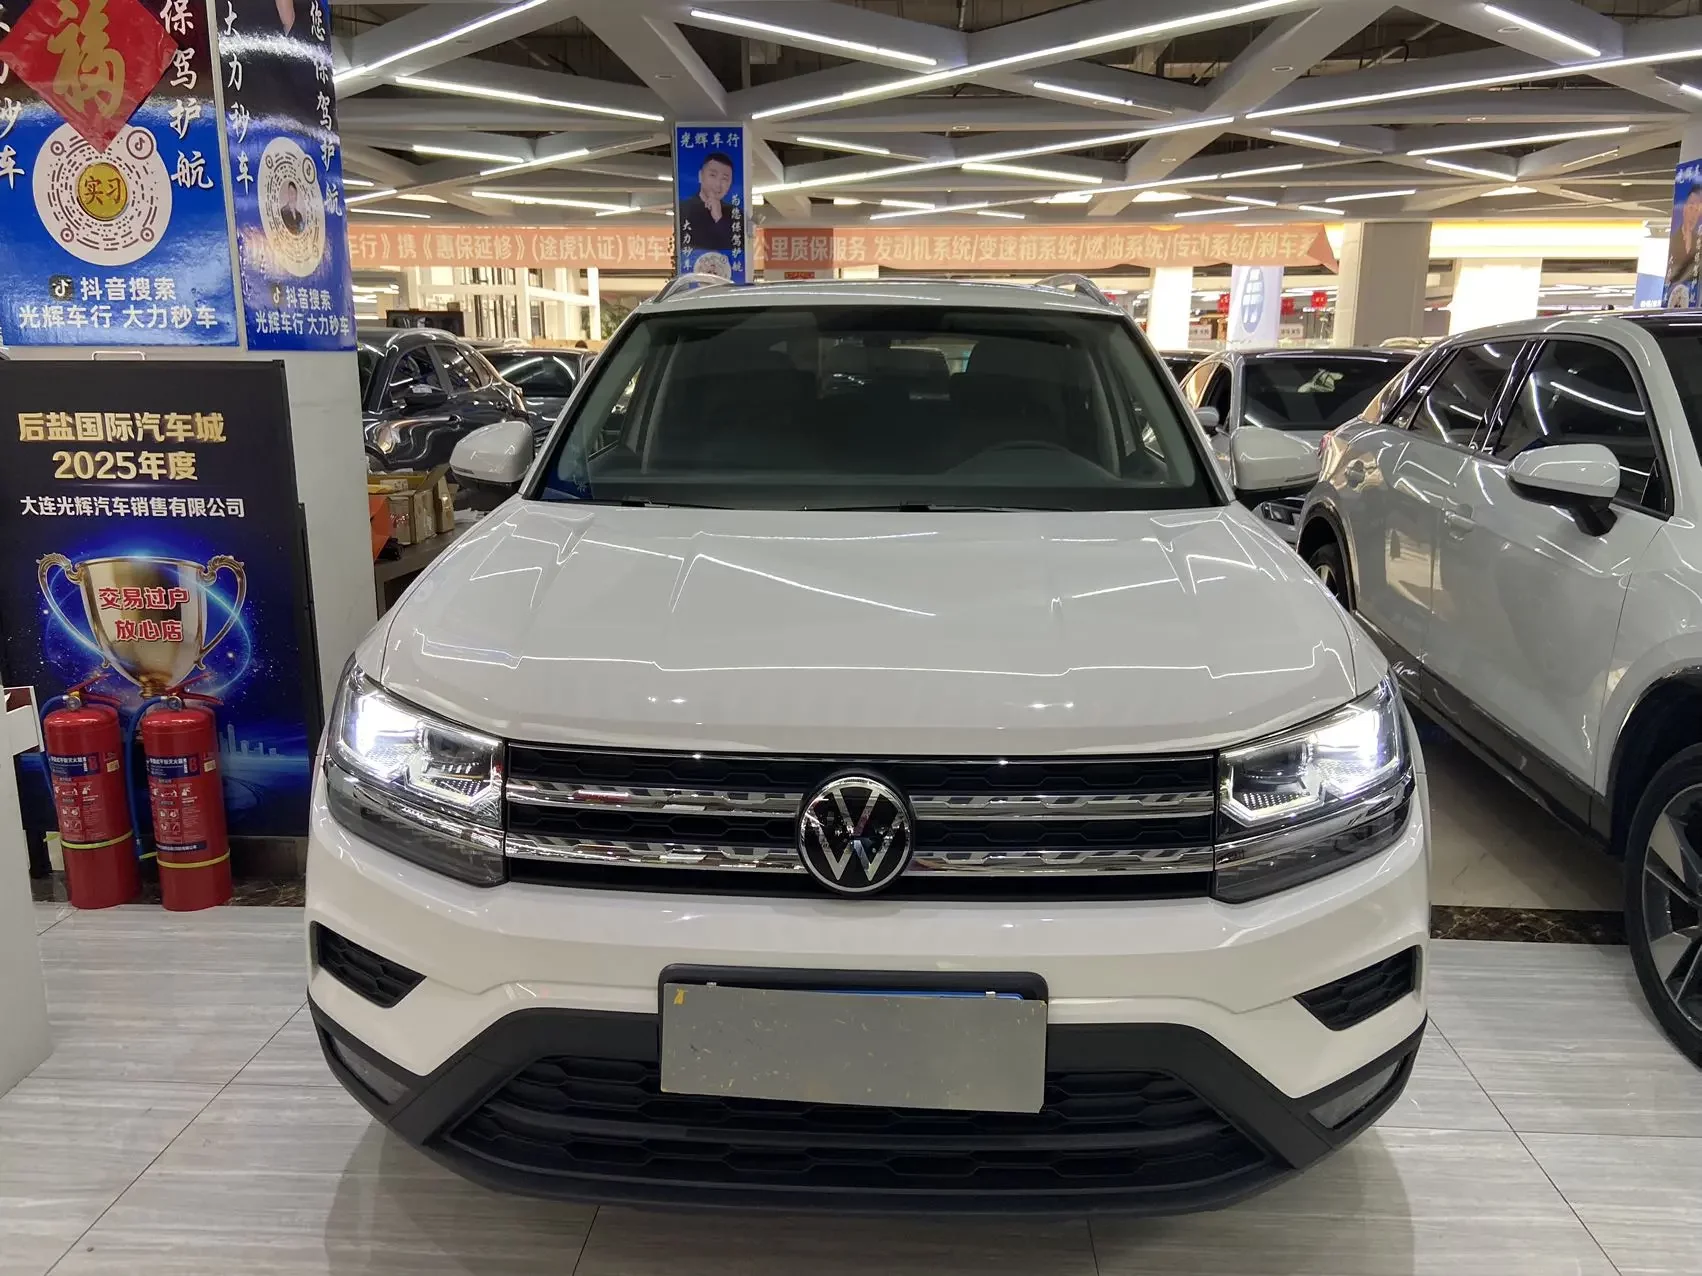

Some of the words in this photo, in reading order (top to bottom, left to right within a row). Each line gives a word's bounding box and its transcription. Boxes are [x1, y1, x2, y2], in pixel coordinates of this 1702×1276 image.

[159, 0, 214, 190] 保驾护航
[223, 1, 254, 195] 大力秒车
[84, 176, 126, 206] 实习
[80, 277, 177, 301] 抖音搜索
[286, 287, 332, 311] 抖音搜索
[19, 305, 113, 329] 光辉车行
[122, 305, 218, 329] 大力秒车
[256, 311, 303, 335] 光辉车行
[307, 313, 349, 337] 大力秒车
[18, 412, 227, 442] 后盐国际汽车城
[52, 451, 198, 481] 2025年度
[20, 496, 246, 518] 大连光辉汽车销售有限公司
[98, 587, 190, 610] 交易过户
[115, 620, 184, 642] 放心店
